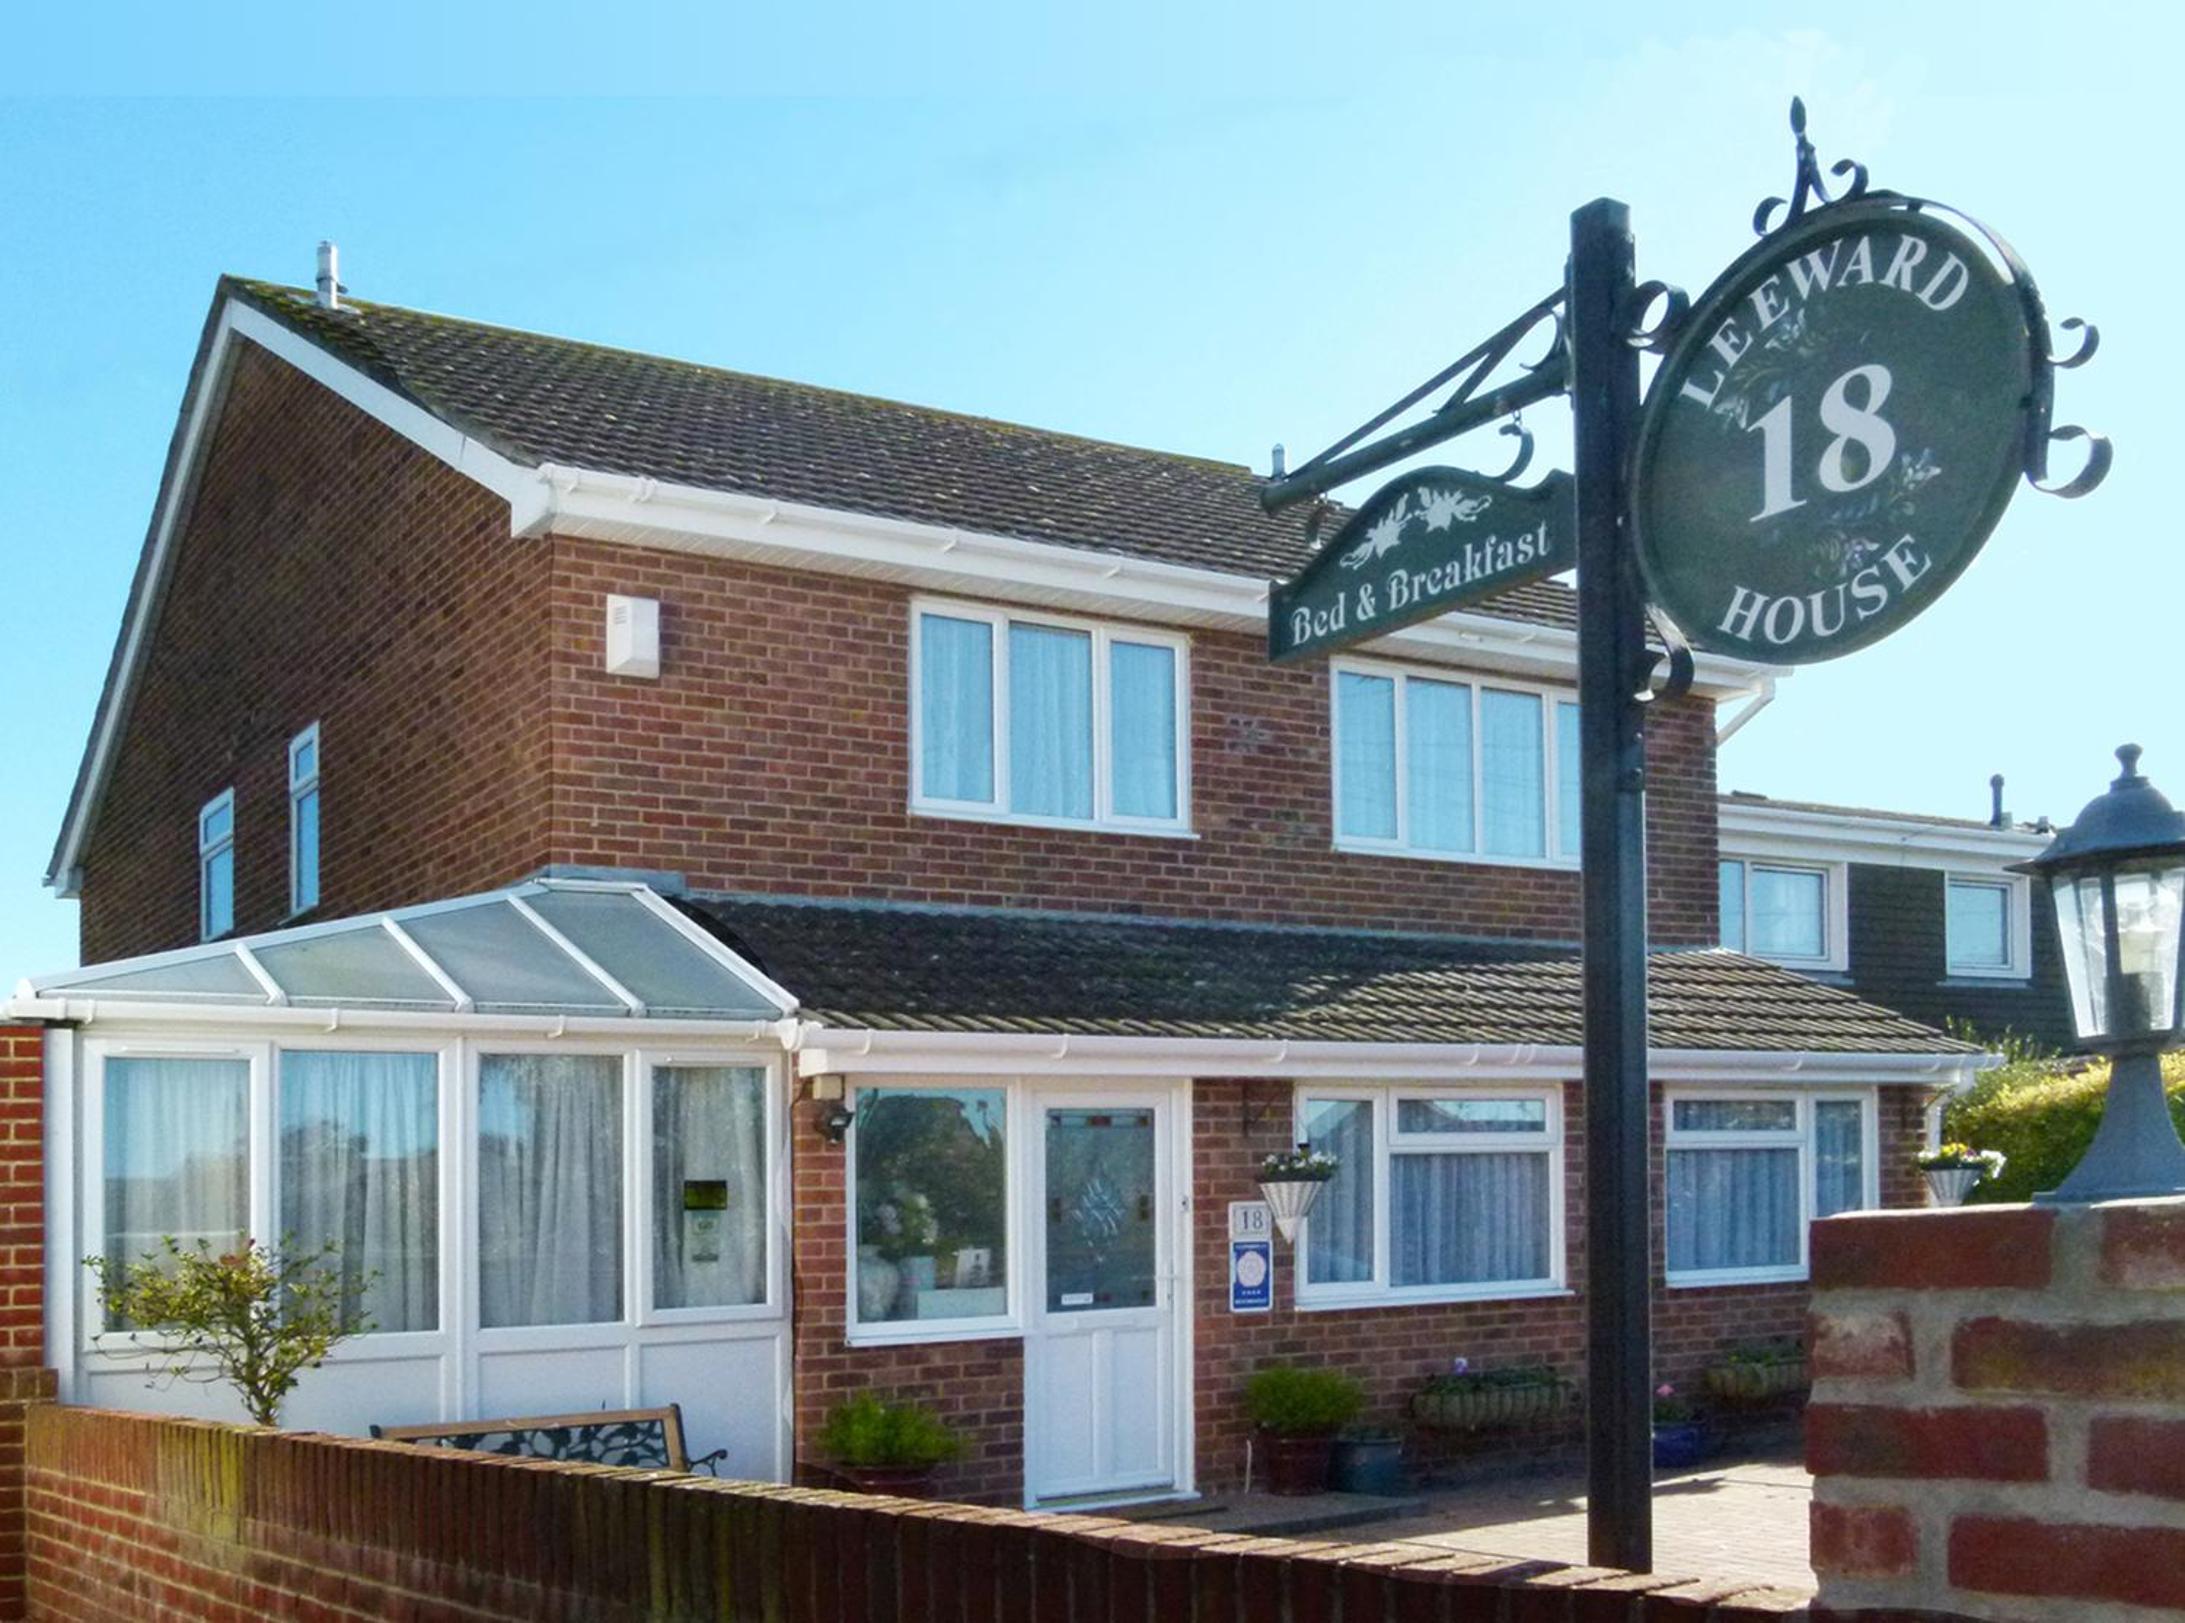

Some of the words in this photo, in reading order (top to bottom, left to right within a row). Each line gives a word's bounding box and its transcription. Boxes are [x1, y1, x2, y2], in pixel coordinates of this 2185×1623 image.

[1681, 234, 1969, 409] LEEWARD
[1746, 364, 1896, 522] 18
[1291, 591, 1346, 646] Bed
[1356, 582, 1376, 621] &
[1387, 519, 1549, 611] Breakfast
[1716, 535, 1932, 644] HOUSE
[1243, 1210, 1263, 1230] 18
